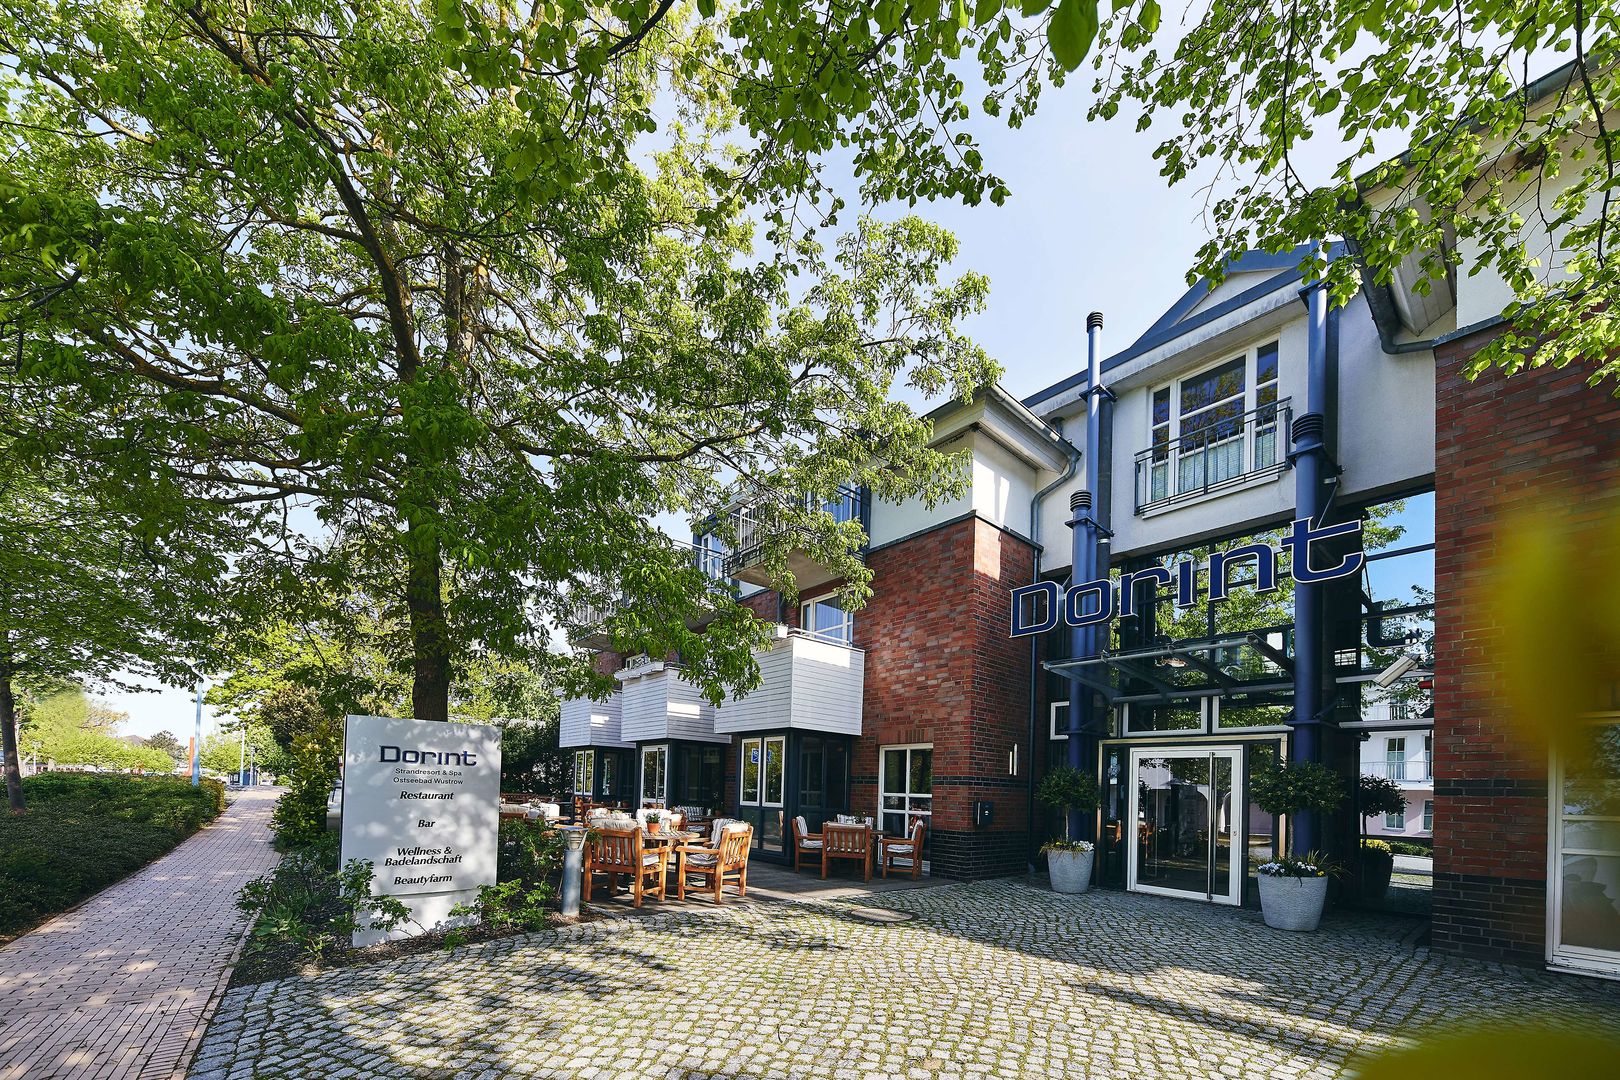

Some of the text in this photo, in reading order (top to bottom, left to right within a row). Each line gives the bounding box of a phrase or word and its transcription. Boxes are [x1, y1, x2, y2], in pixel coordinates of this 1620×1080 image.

[1009, 516, 1364, 638] Dorint
[379, 745, 477, 766] Dorint
[395, 768, 441, 776] Strandresort
[399, 791, 455, 800] Restaurant
[417, 819, 436, 828] Bar
[397, 846, 453, 856] Wellness &
[385, 855, 463, 867] Badelandschaft
[394, 874, 453, 886] Beautyfarm
